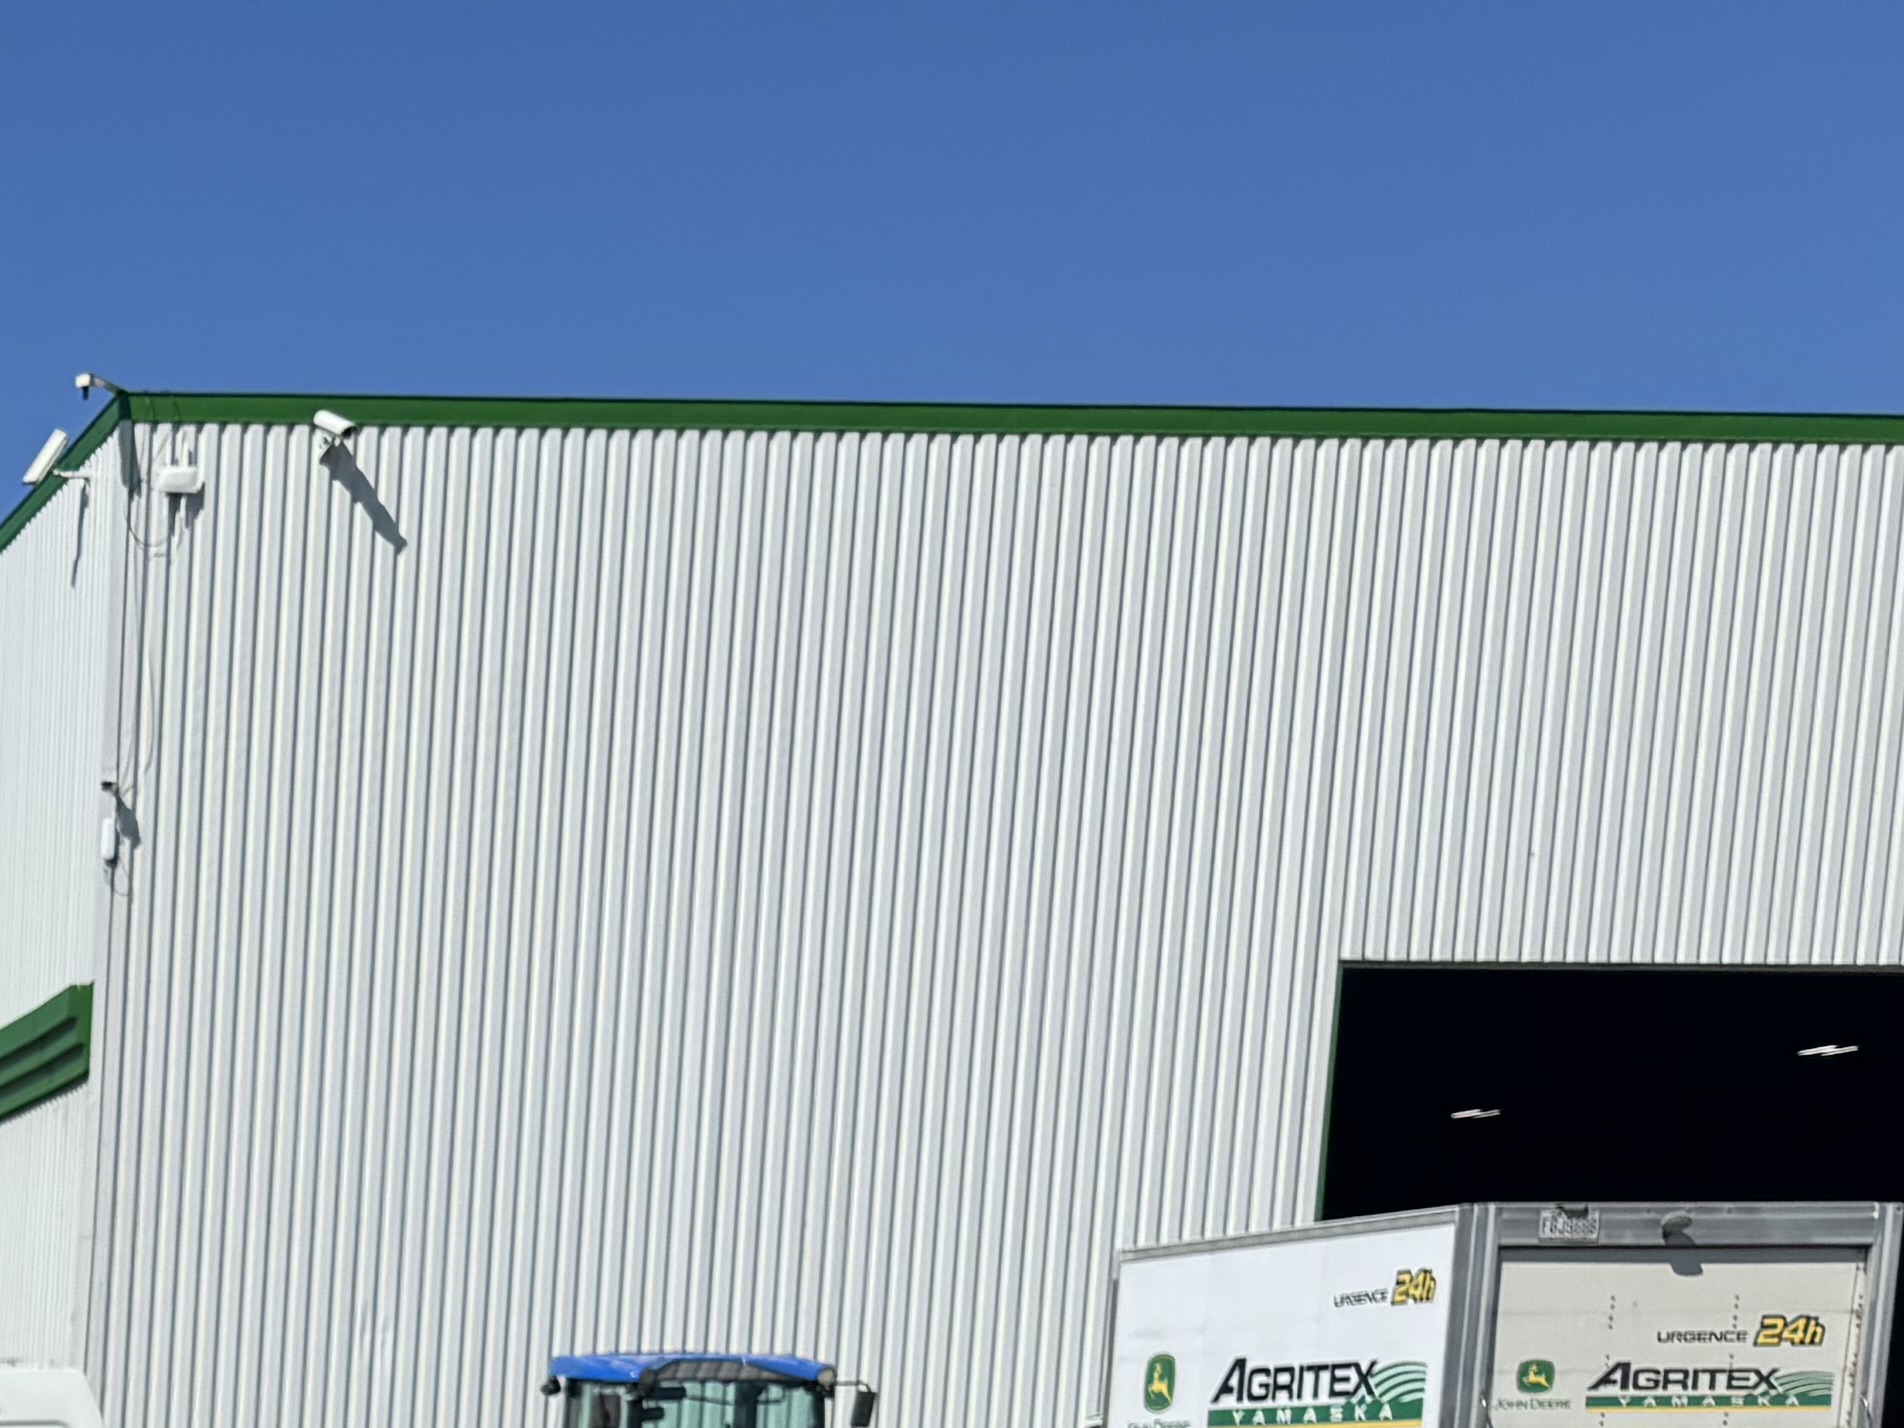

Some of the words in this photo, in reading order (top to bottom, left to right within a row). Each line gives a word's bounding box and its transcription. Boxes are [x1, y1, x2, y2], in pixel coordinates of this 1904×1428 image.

[1391, 1269, 1437, 1305] 24h
[1657, 1330, 1748, 1343] URGENCE
[1753, 1315, 1825, 1346] 24h
[1210, 1358, 1377, 1404] AGRITEX
[1586, 1361, 1780, 1391] AGRITEX
[1232, 1404, 1394, 1426] YAMASKA
[1530, 1397, 1571, 1410] DEERE
[1618, 1395, 1801, 1407] YAMASKA
